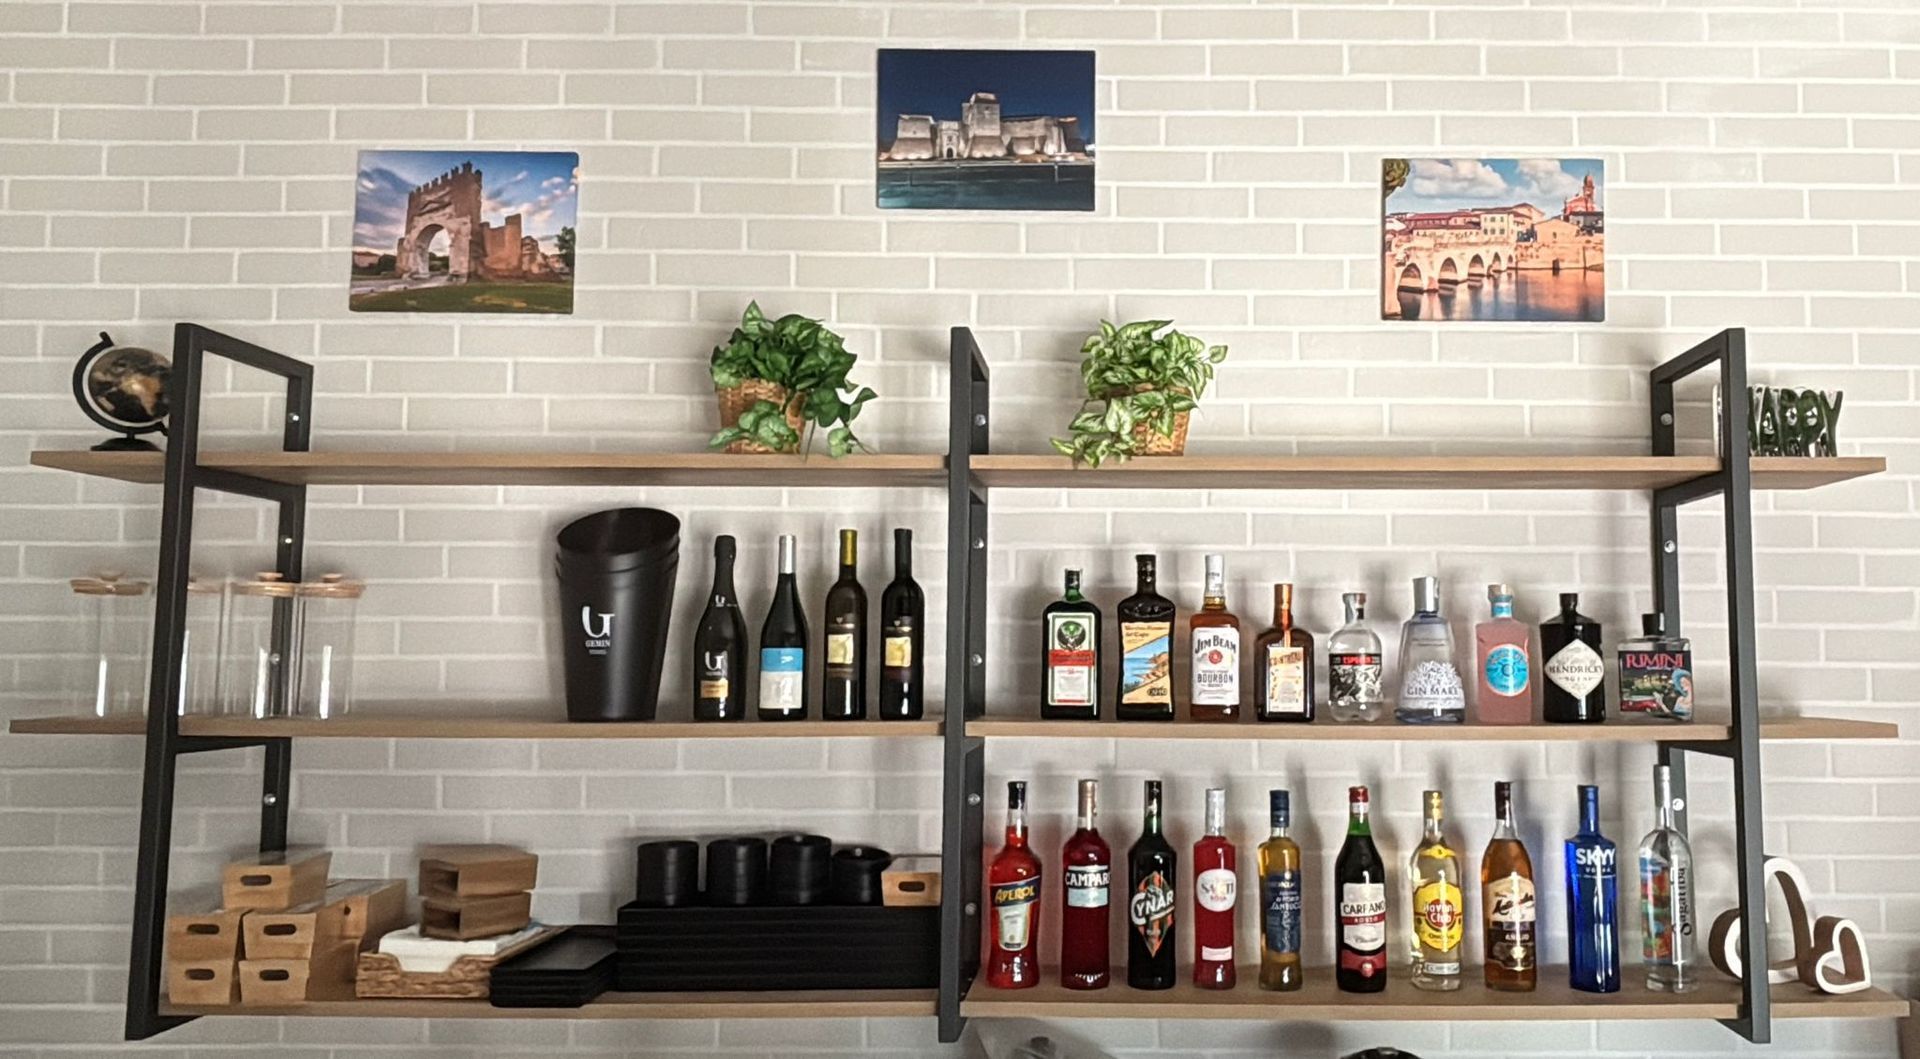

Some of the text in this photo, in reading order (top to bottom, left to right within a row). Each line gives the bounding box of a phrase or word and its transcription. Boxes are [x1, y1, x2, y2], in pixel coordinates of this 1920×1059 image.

[1747, 386, 1843, 456] APPY
[1195, 635, 1236, 654] JIM BEAM
[1197, 673, 1233, 684] BOURBON
[1575, 848, 1615, 865] SKYY
[1065, 872, 1109, 887] CAMPAR
[1201, 882, 1234, 895] SATI
